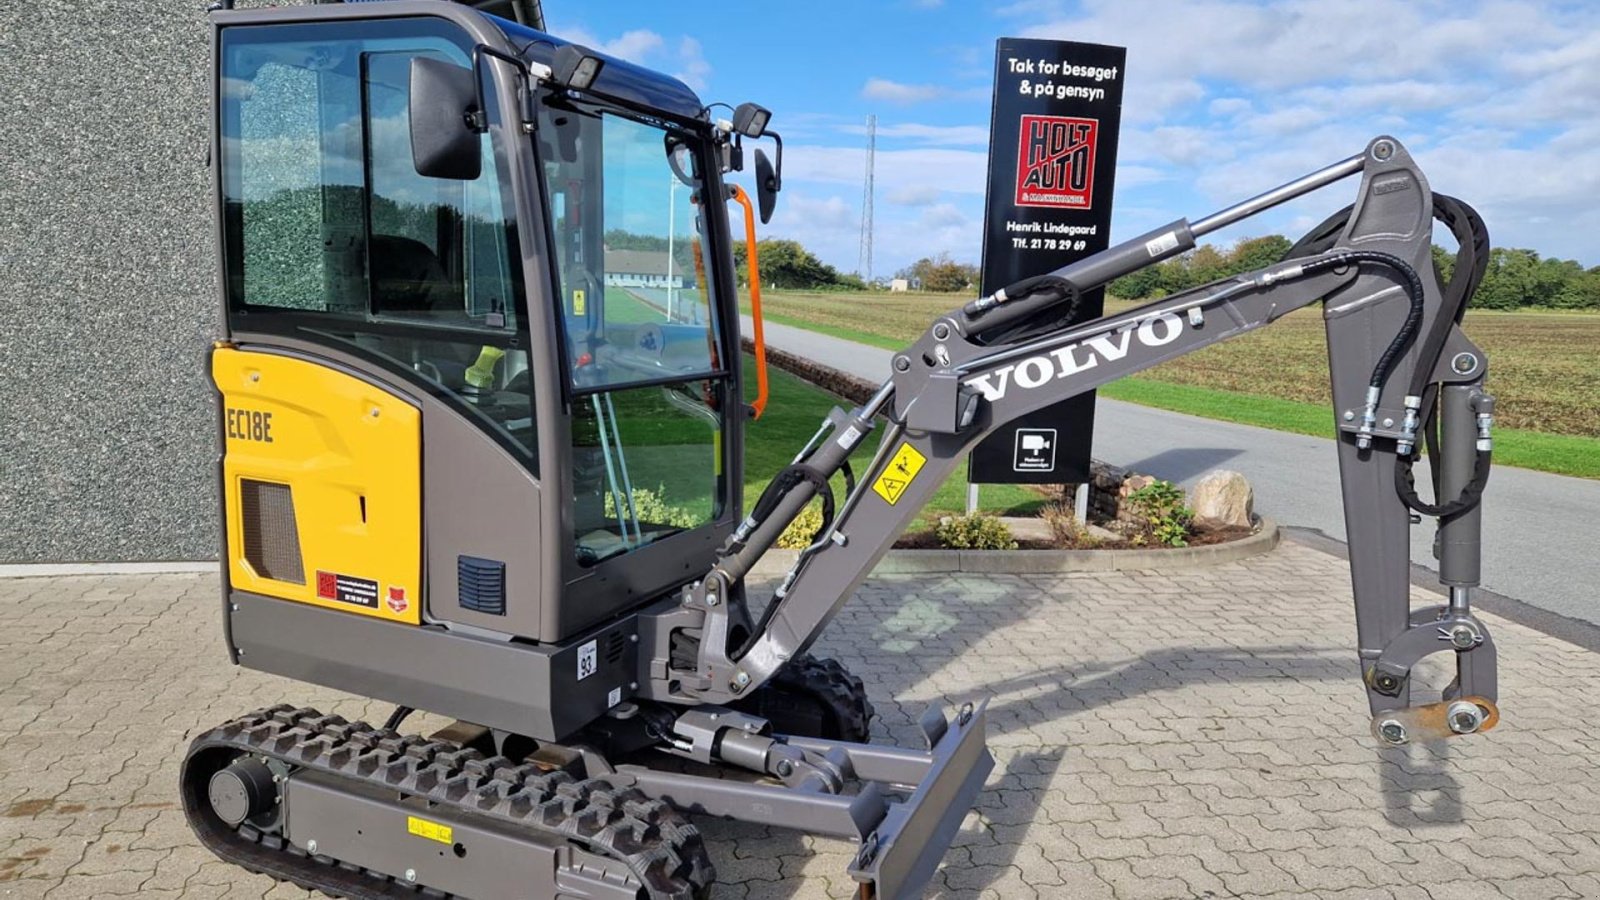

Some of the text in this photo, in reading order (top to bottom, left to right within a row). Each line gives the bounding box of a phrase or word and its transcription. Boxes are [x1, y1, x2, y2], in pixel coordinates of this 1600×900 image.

[1008, 57, 1118, 82] Tak for besøget
[1019, 79, 1105, 102] & på gensyn
[1028, 120, 1092, 168] HOLT
[1022, 144, 1090, 191] AUTO
[1006, 221, 1097, 237] Henrik Lindegaard
[1012, 238, 1087, 252] Tlf. 21 78 29 69
[964, 312, 1184, 402] VOLVO
[226, 407, 274, 443] EC18E
[581, 655, 592, 677] 93
